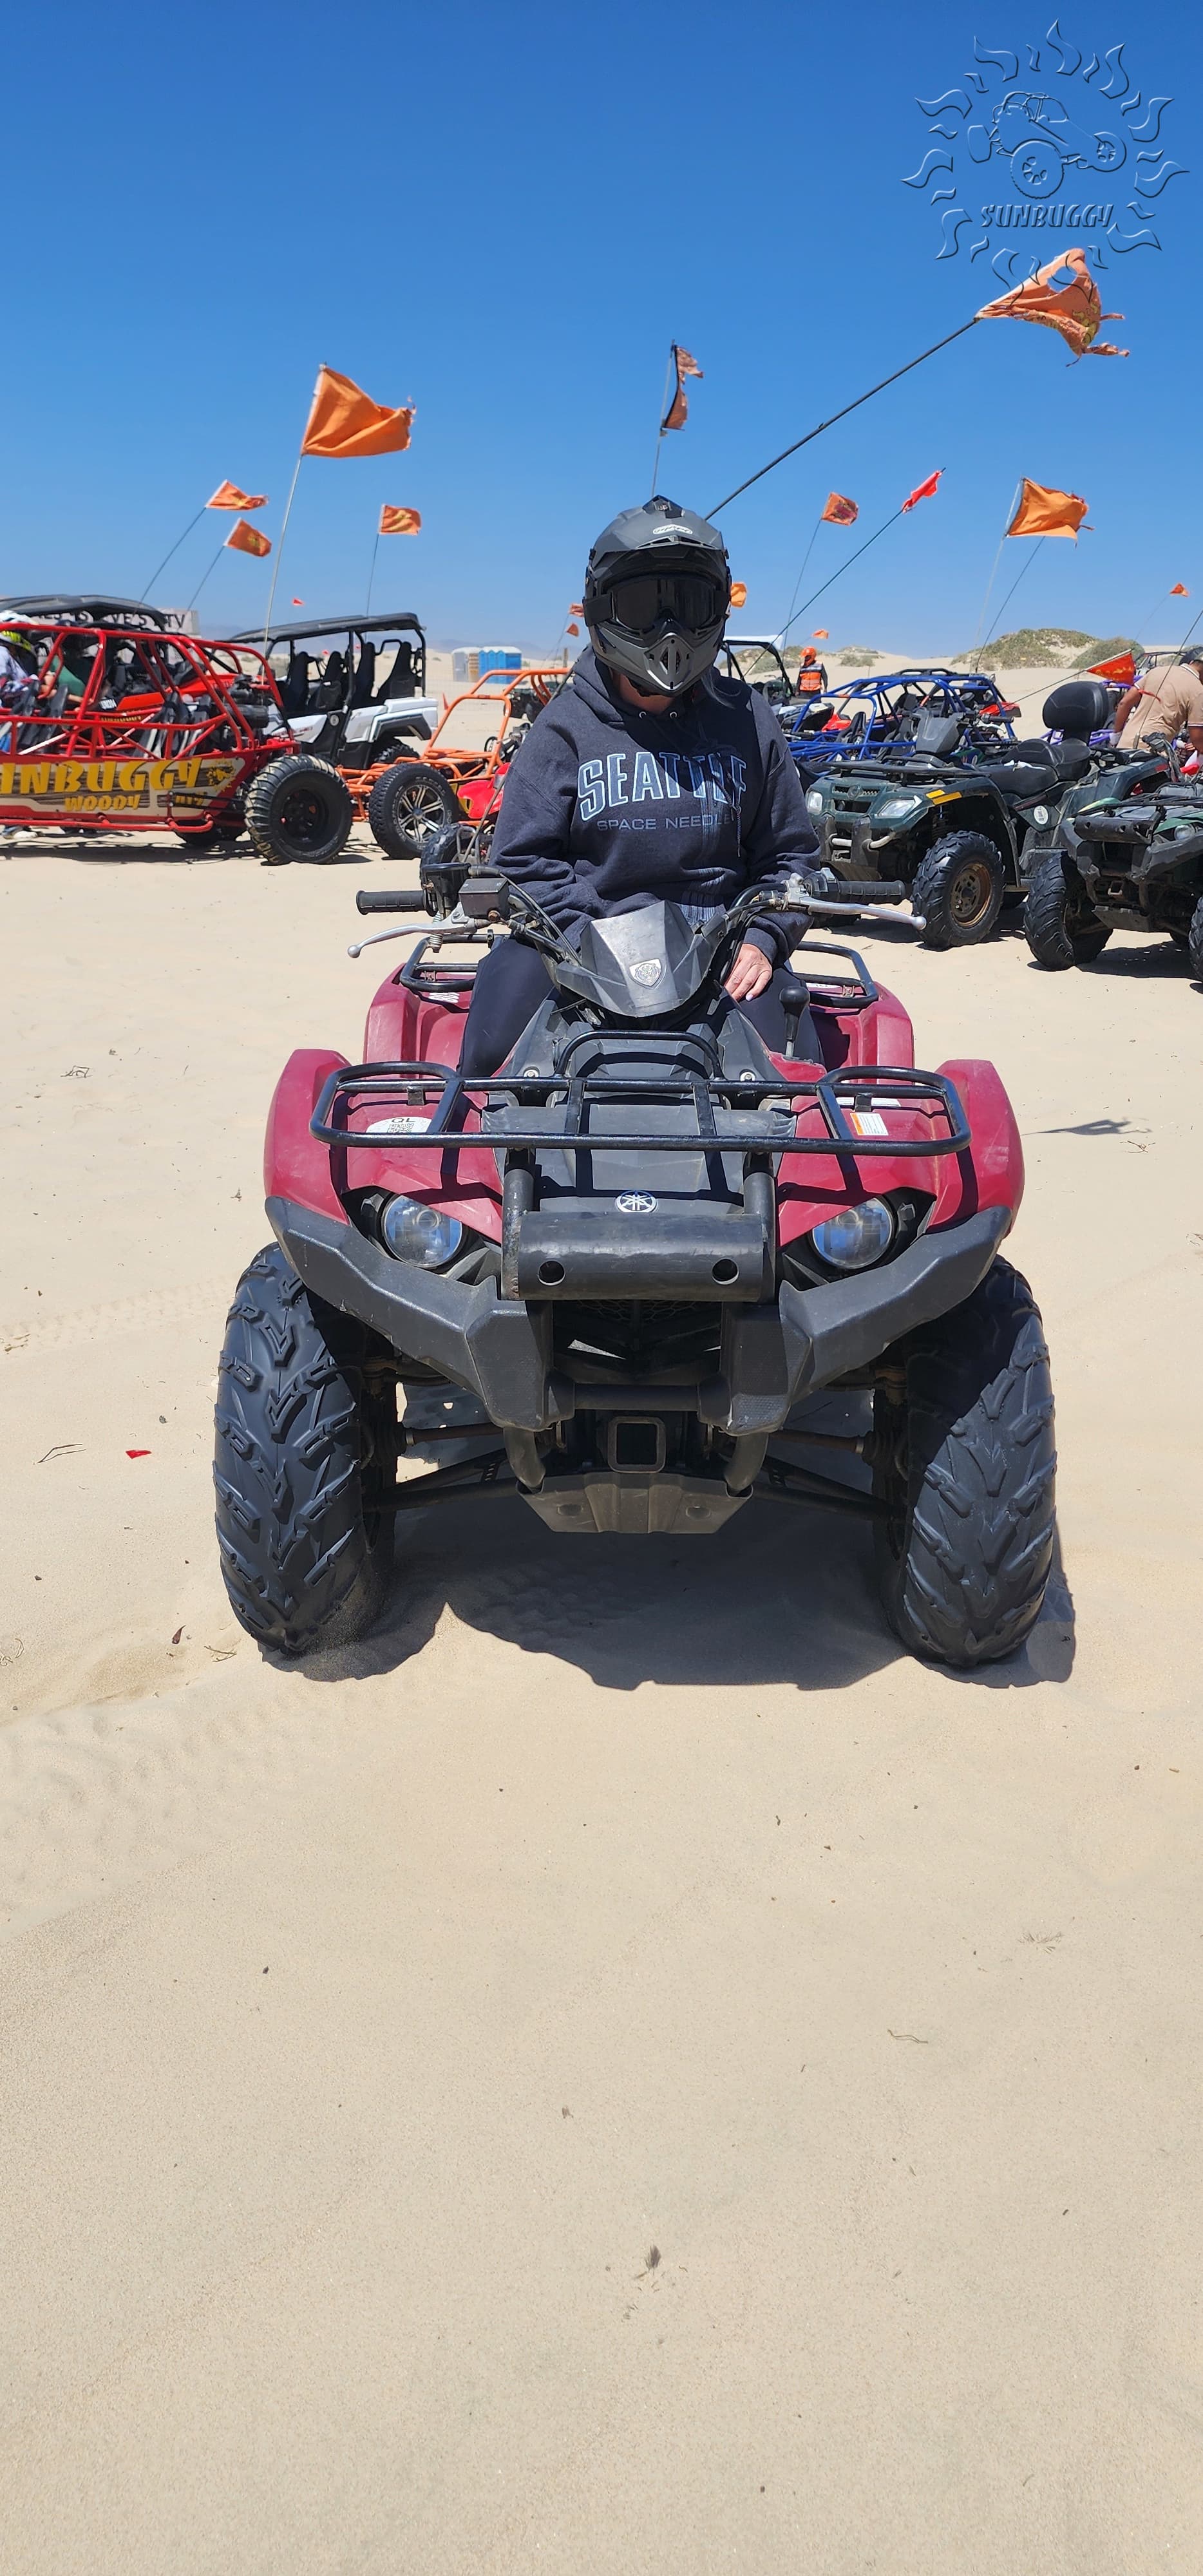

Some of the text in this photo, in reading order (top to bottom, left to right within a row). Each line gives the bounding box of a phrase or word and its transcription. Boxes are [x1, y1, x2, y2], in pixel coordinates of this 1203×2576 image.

[578, 752, 746, 821] SEATTLE
[65, 794, 140, 811] WOODY
[596, 813, 730, 831] SPACE NEEDLE
